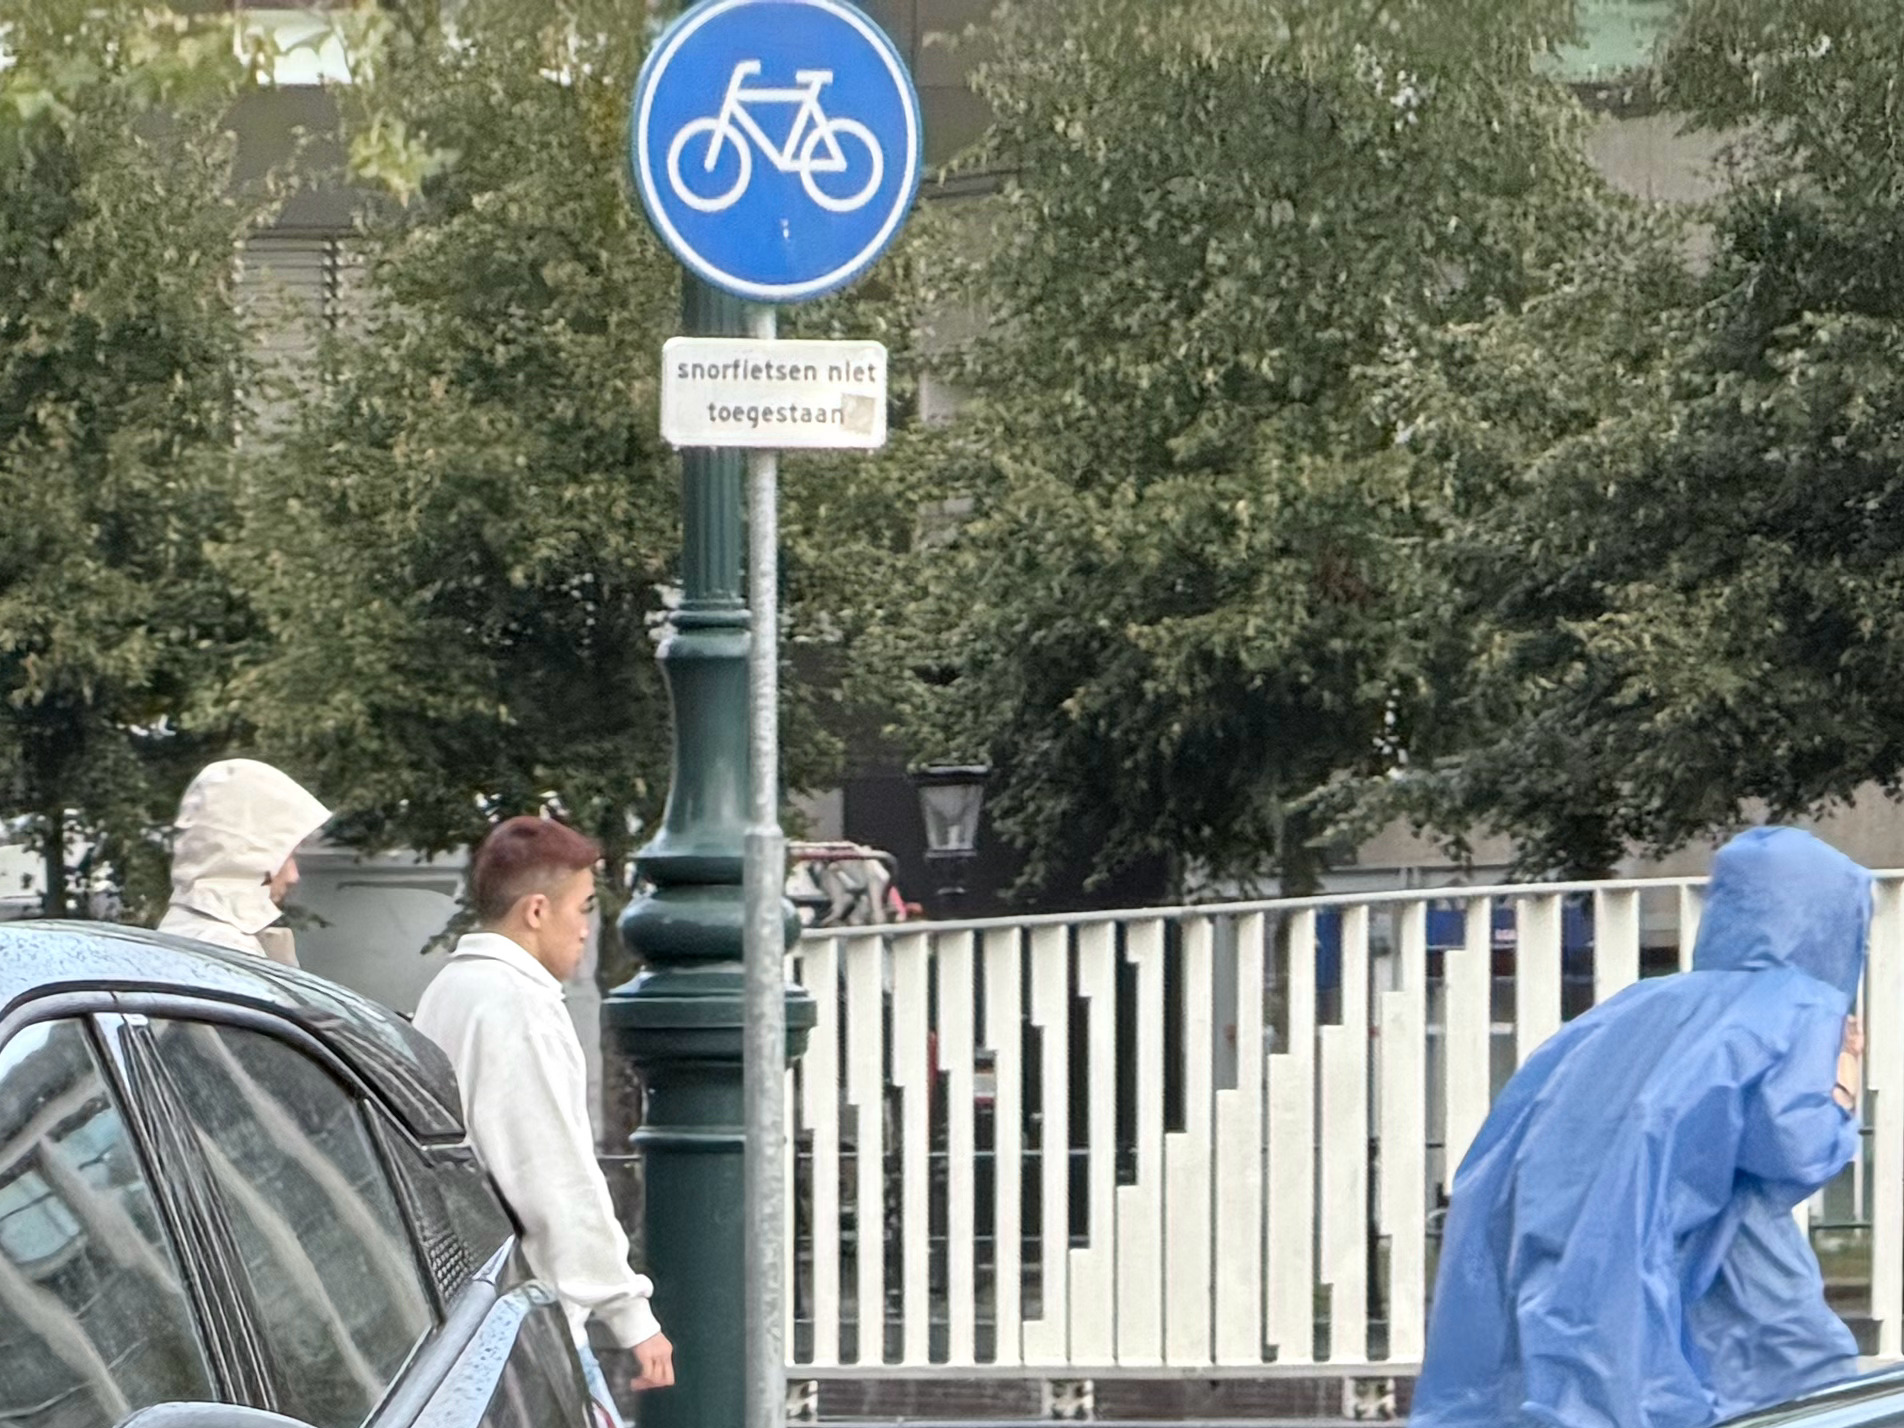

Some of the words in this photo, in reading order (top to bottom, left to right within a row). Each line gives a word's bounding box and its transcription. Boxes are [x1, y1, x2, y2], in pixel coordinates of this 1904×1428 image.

[677, 359, 817, 382] snorfietsen
[828, 360, 877, 383] niet
[707, 402, 845, 429] toegestaan
